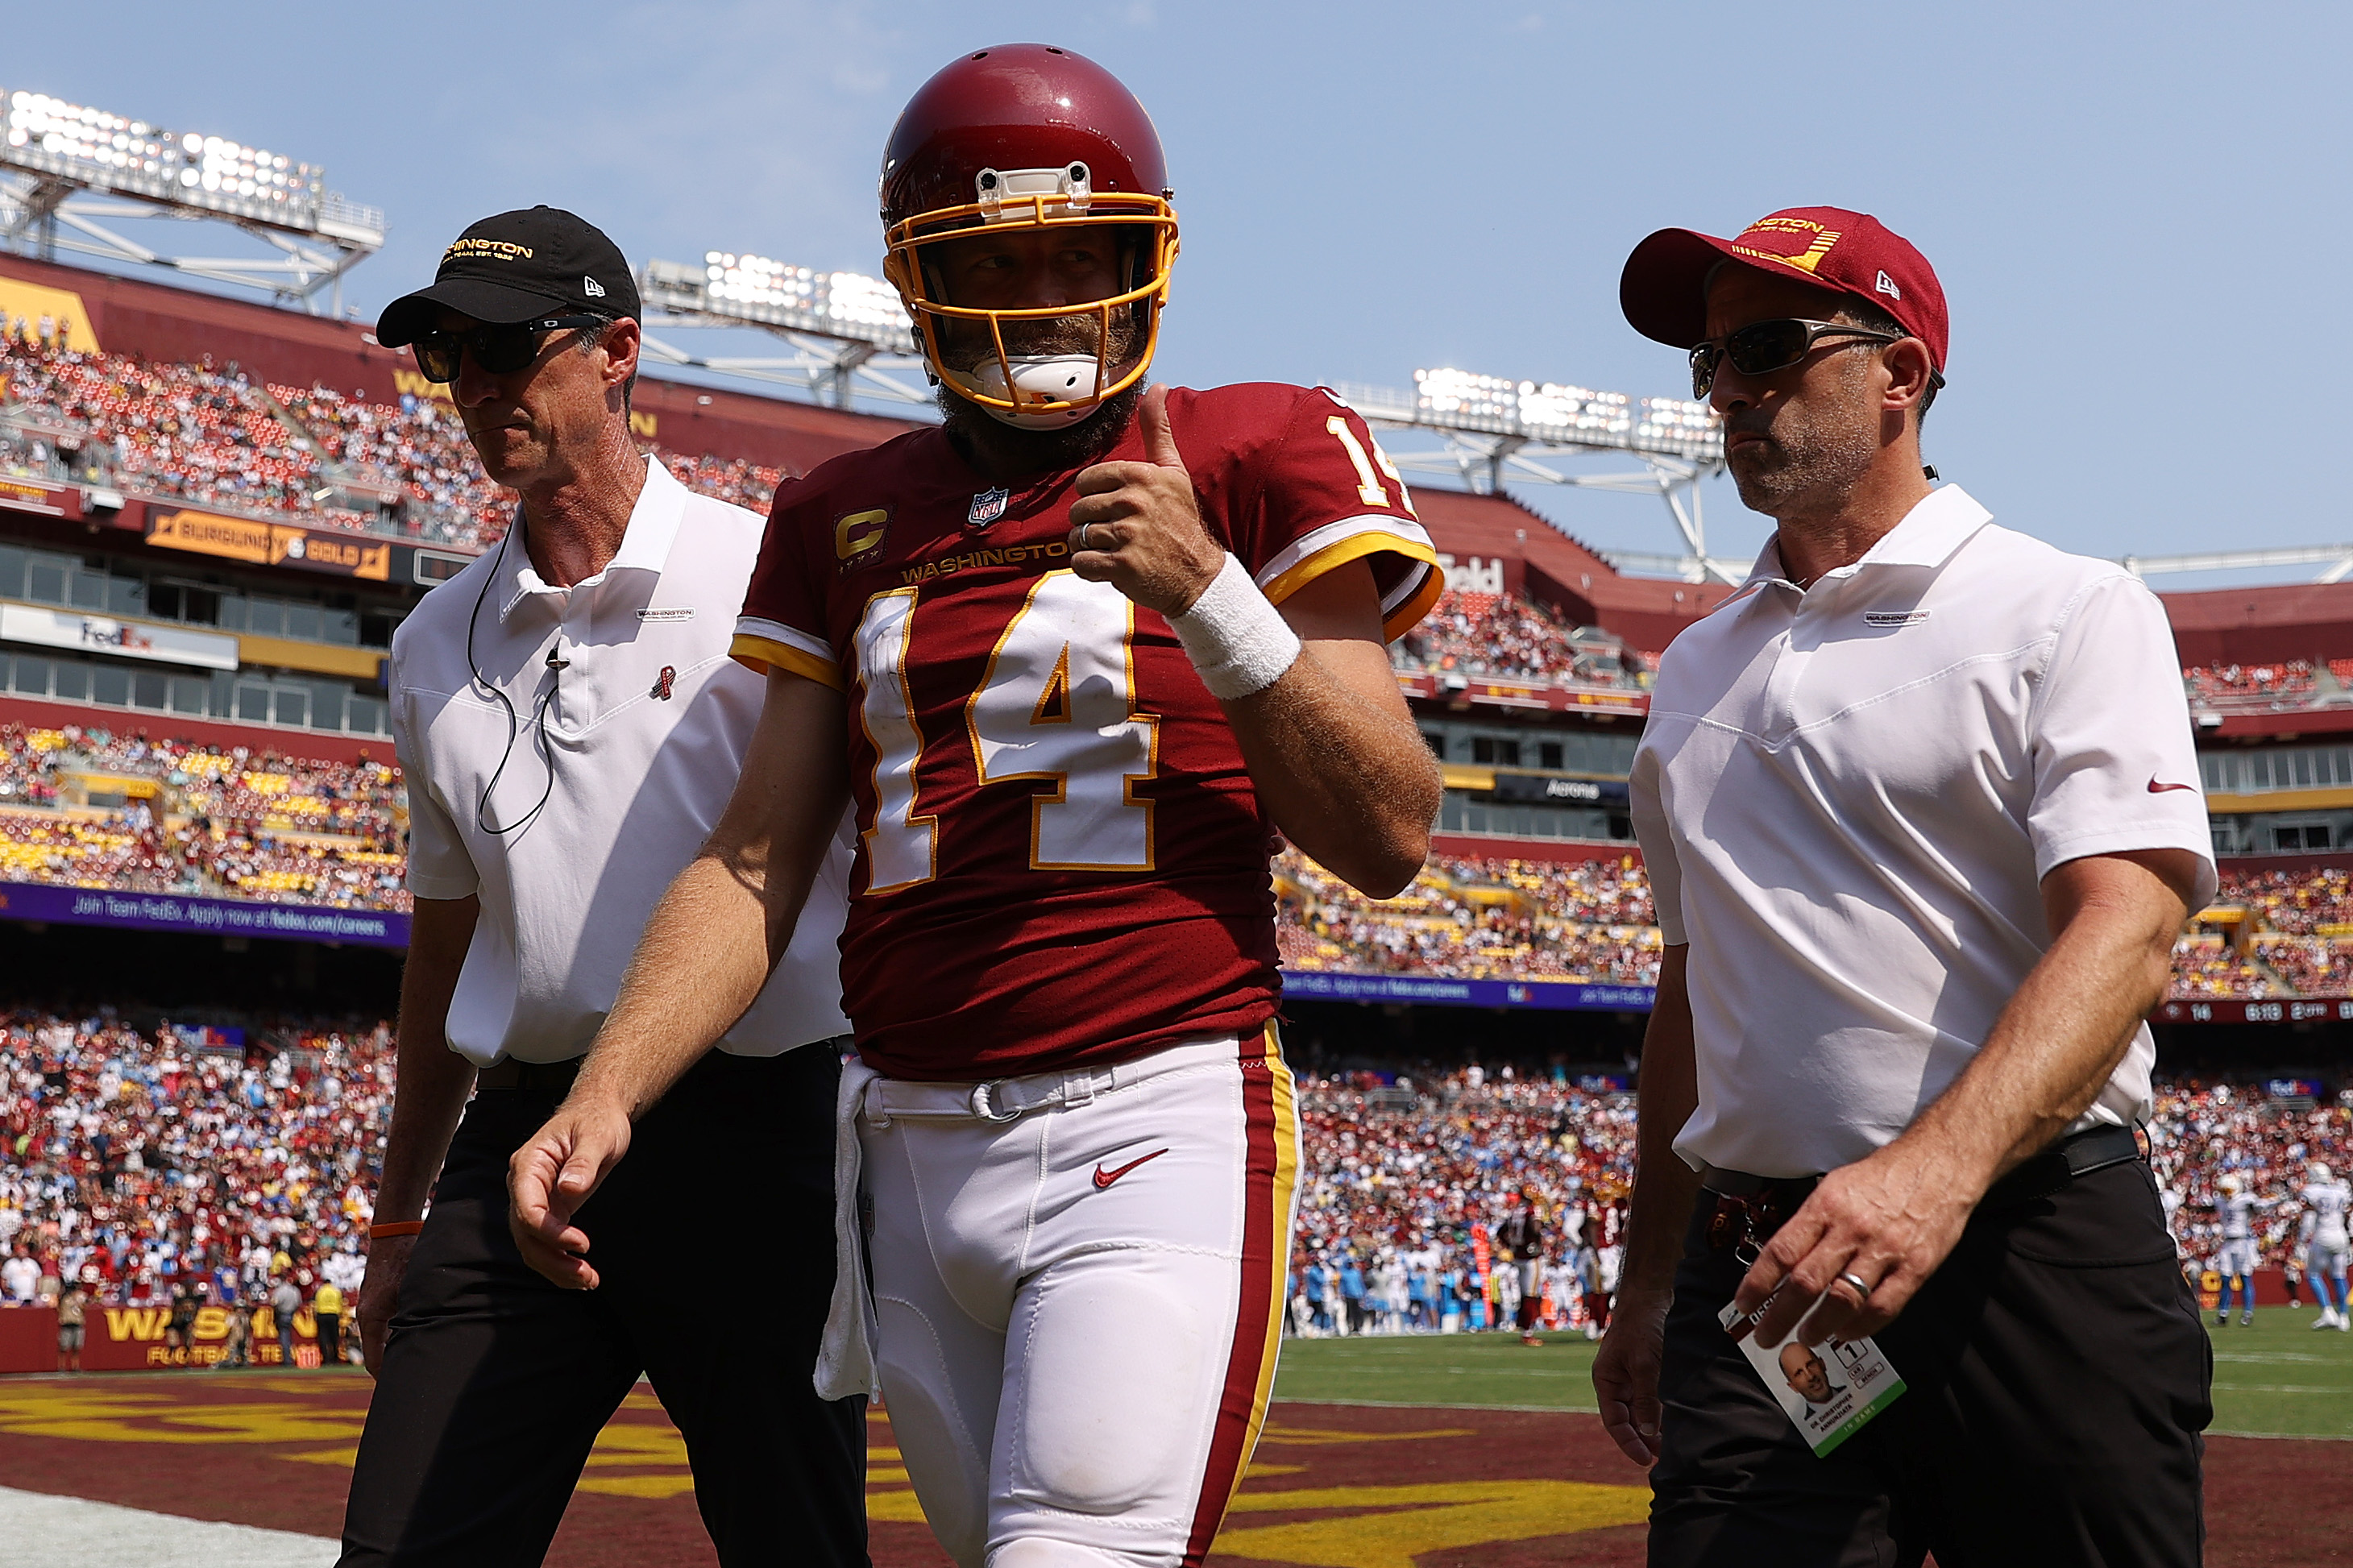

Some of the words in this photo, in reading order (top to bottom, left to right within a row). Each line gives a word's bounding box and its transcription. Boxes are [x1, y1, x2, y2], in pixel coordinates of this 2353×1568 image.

[836, 508, 888, 560] C
[306, 539, 361, 566] GOLD
[900, 541, 1069, 583] WASHINGTO
[1865, 612, 1928, 620] WASHINGTON
[82, 620, 153, 650] FedEx
[853, 567, 1161, 896] 14
[72, 894, 103, 915] Join
[104, 897, 140, 918] Team
[1845, 1343, 1858, 1359] 1
[1861, 1367, 1878, 1383] BENCH
[1819, 1393, 1853, 1424] CHRISTOPHER
[1820, 1404, 1854, 1433] ANNUNZIATA
